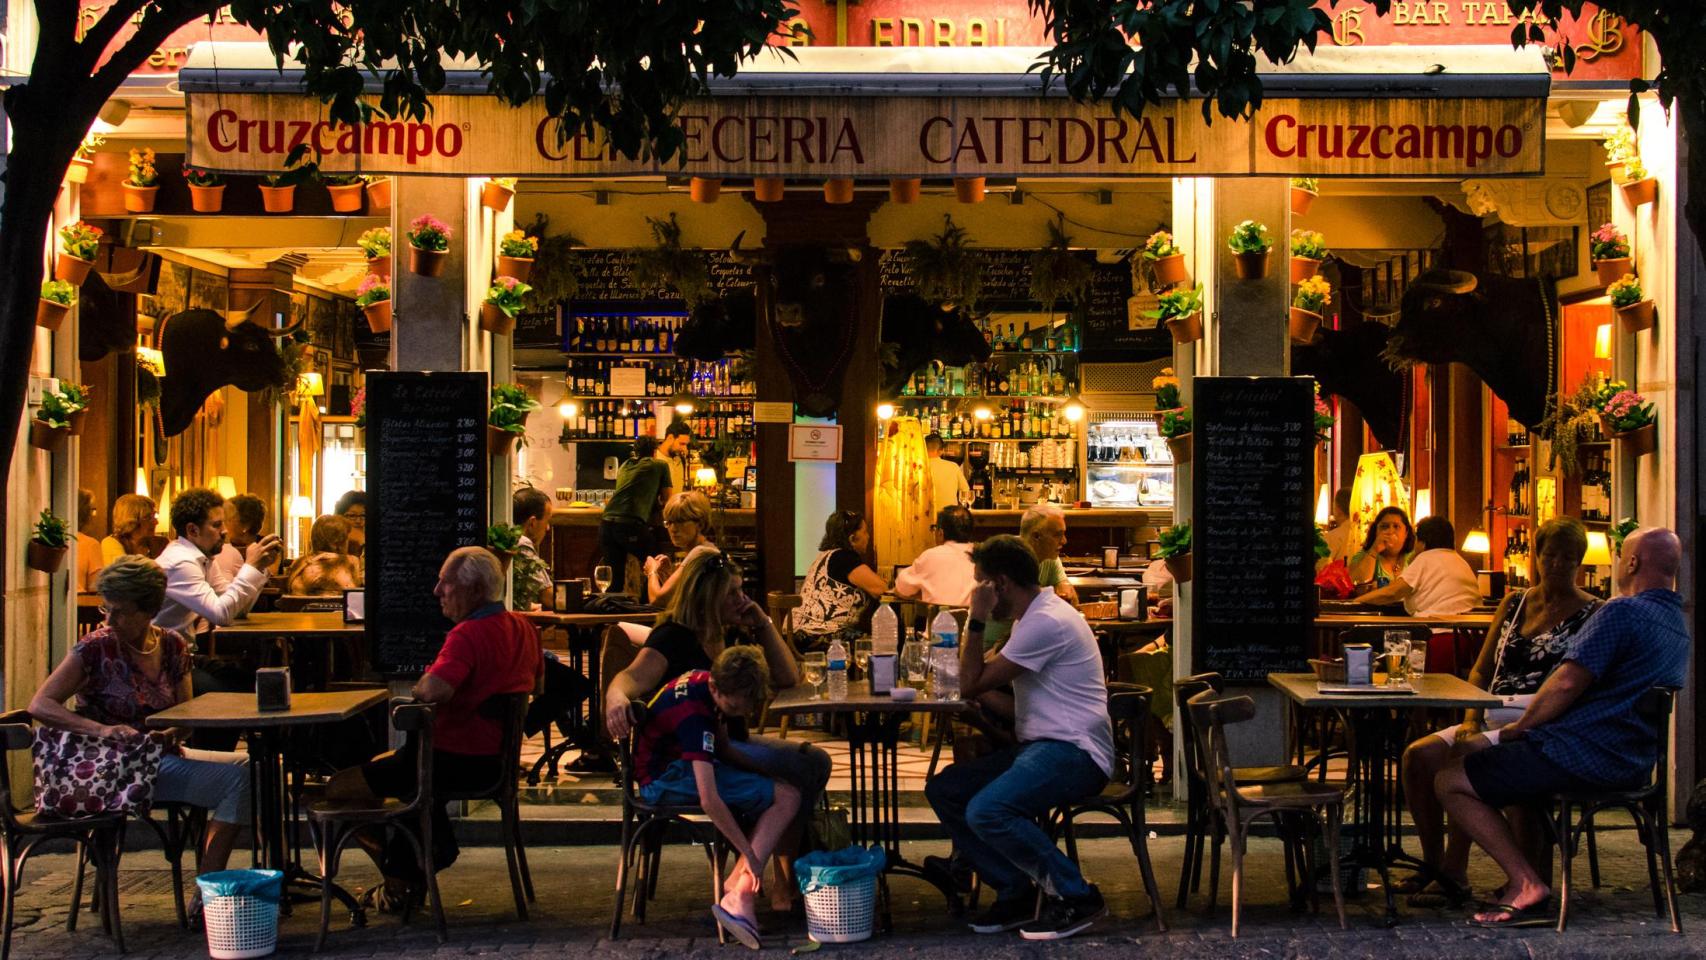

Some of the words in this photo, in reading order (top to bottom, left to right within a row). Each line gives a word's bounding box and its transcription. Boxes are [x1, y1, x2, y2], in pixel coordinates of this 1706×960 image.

[1393, 1, 1450, 25] BAR
[1462, 2, 1551, 25] TAPA
[207, 109, 463, 165] Cruzcampo
[535, 115, 865, 165] CEECERIA
[919, 116, 1197, 165] CATEDRAL
[1265, 114, 1523, 168] Cruzcampo
